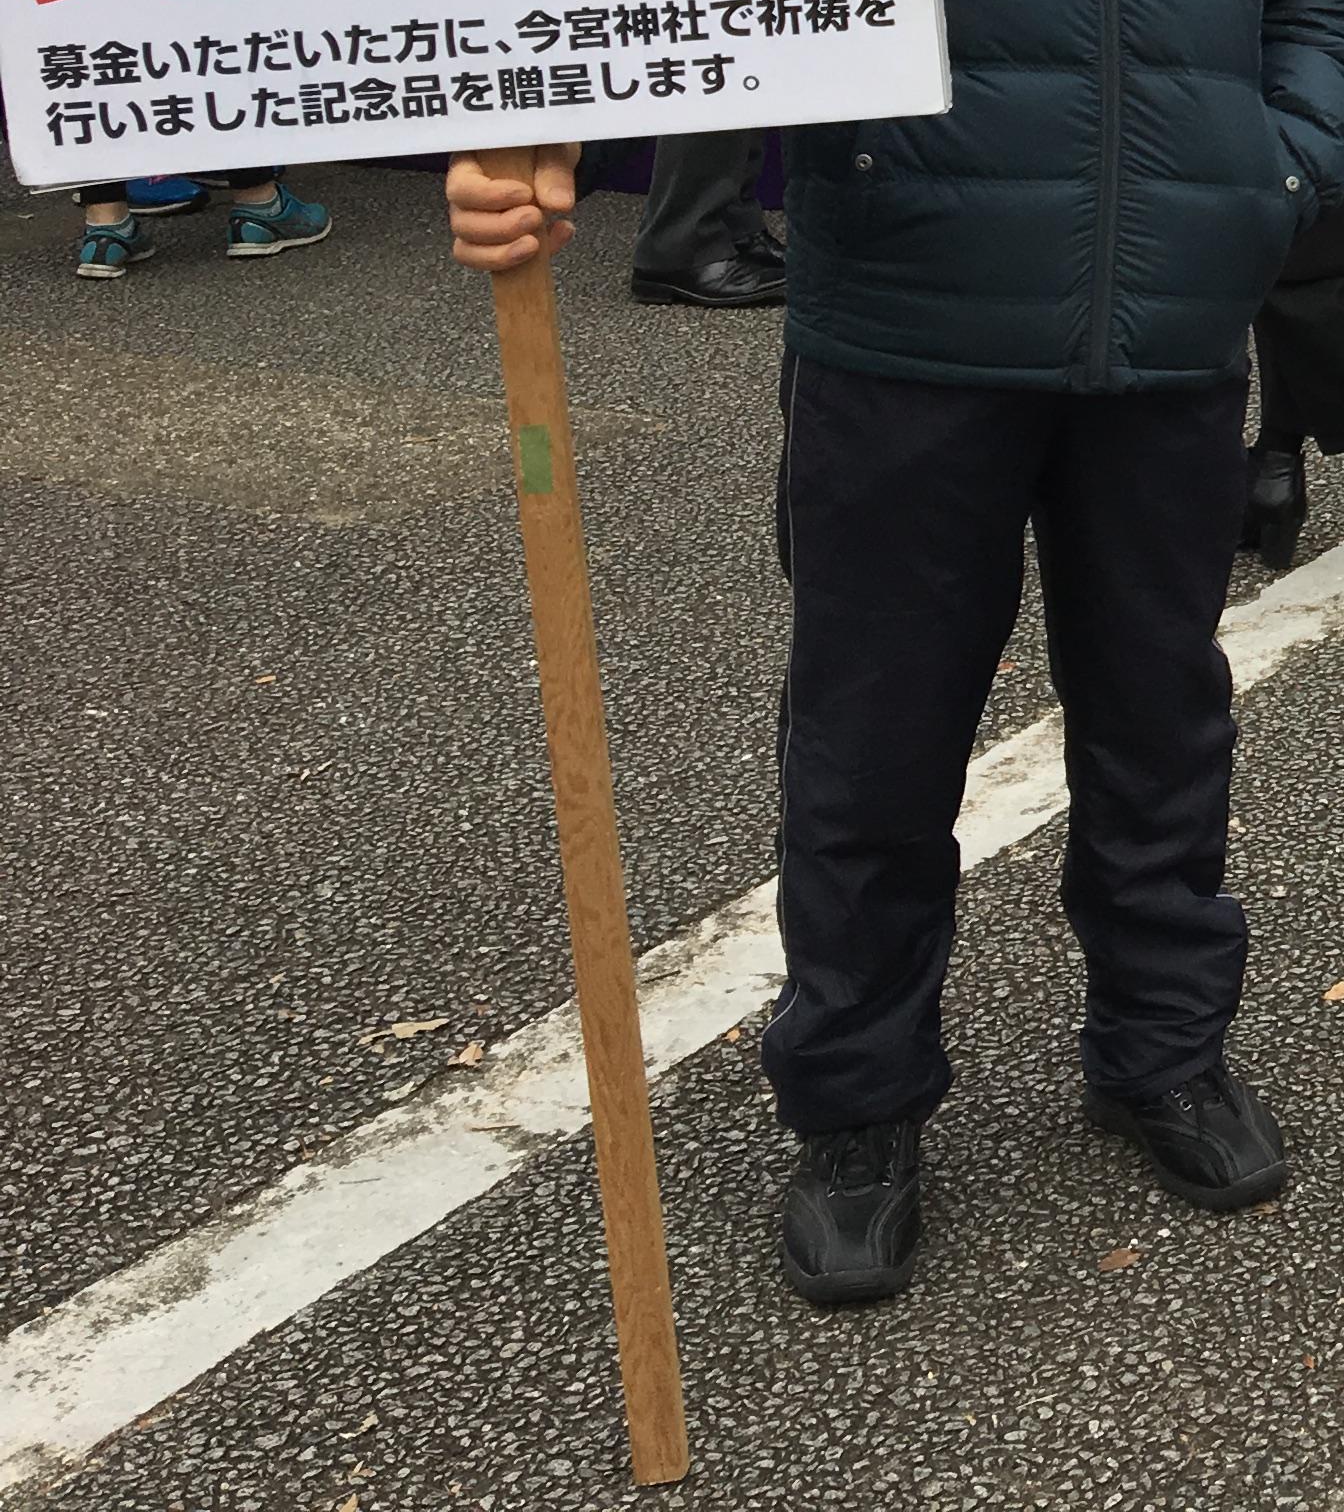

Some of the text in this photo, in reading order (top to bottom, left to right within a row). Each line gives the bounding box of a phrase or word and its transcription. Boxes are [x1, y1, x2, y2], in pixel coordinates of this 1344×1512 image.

[46, 51, 762, 147] 行いました記念品を贈呈します。
